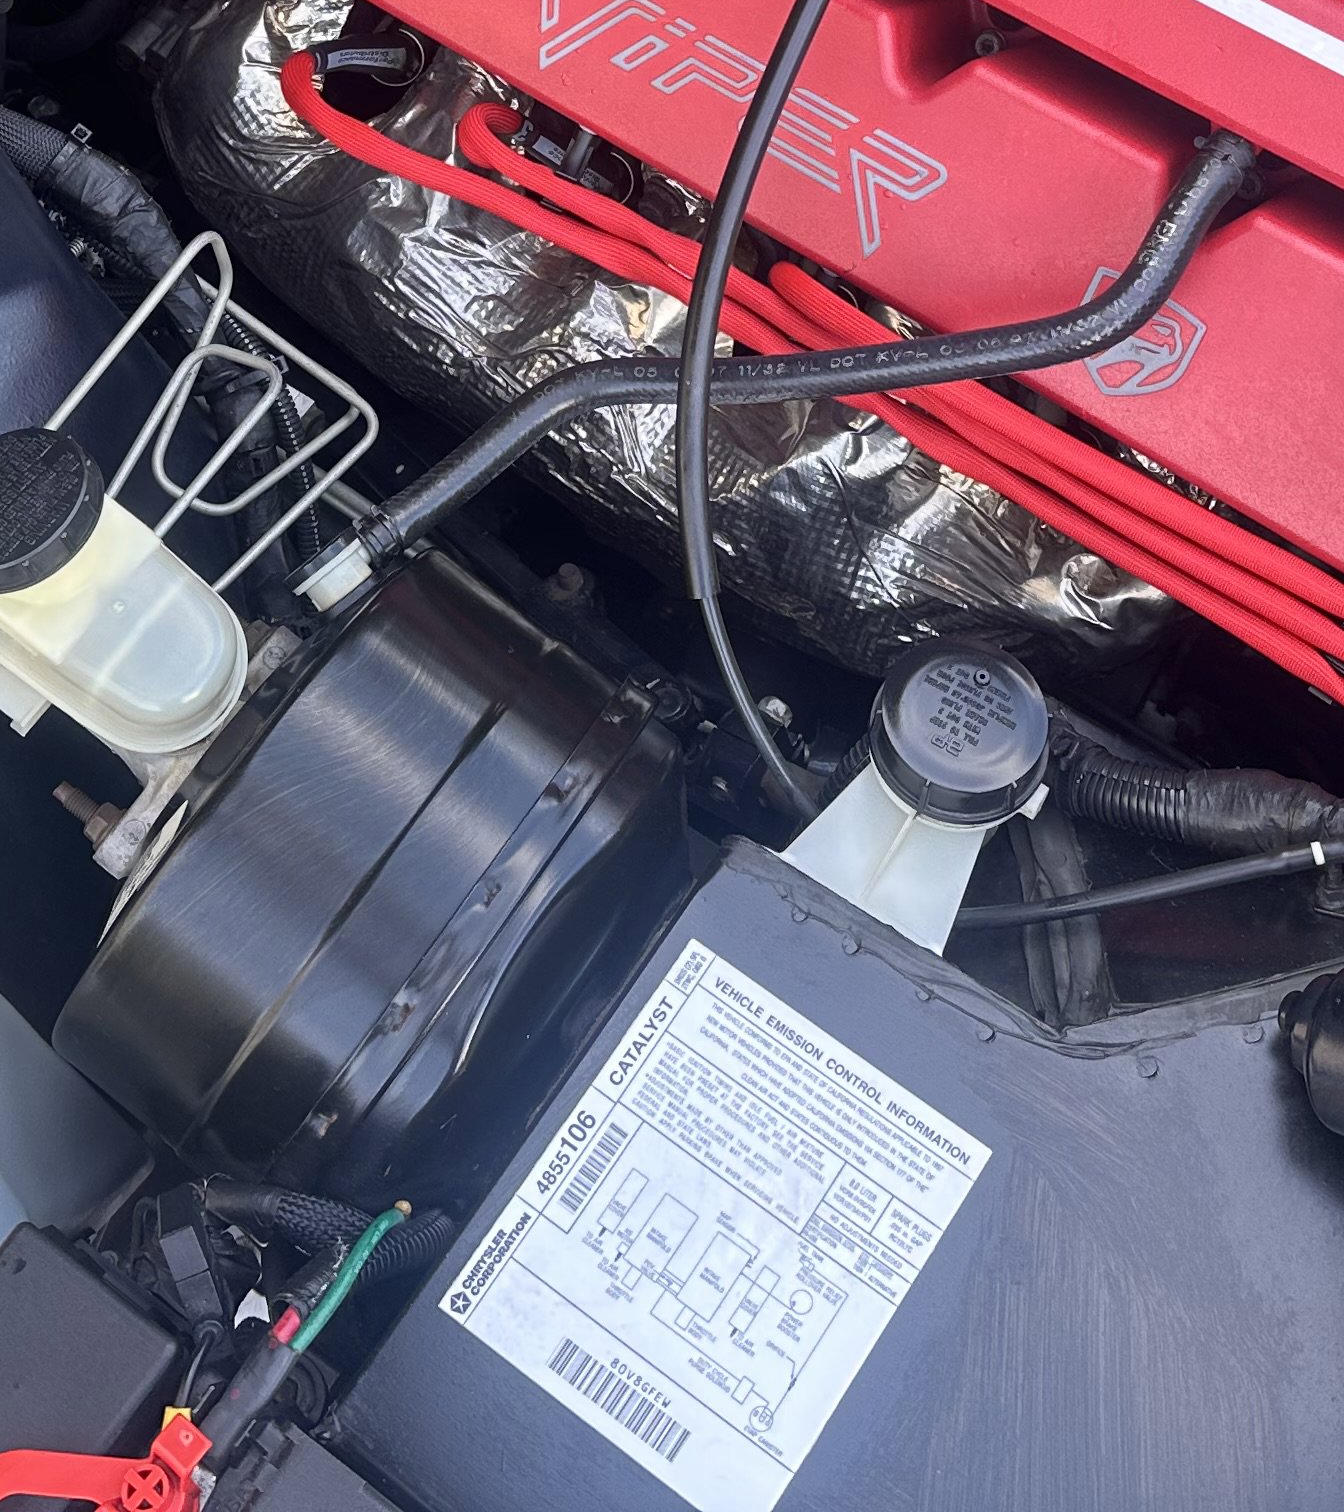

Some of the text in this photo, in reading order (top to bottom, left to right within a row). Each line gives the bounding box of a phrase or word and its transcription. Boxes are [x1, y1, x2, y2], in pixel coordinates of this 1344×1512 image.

[606, 995, 676, 1087] CATALYST
[712, 976, 971, 1166] VEHICLE EMISSION CONTROL INFORMATION
[801, 1067, 819, 1083] STATE
[529, 1108, 598, 1196] 4855106
[906, 1159, 926, 1176] STATE
[460, 1227, 508, 1291] CHRYSLER
[468, 1211, 532, 1297] CORPORATION
[608, 1356, 672, 1409] 80V8GFEW
